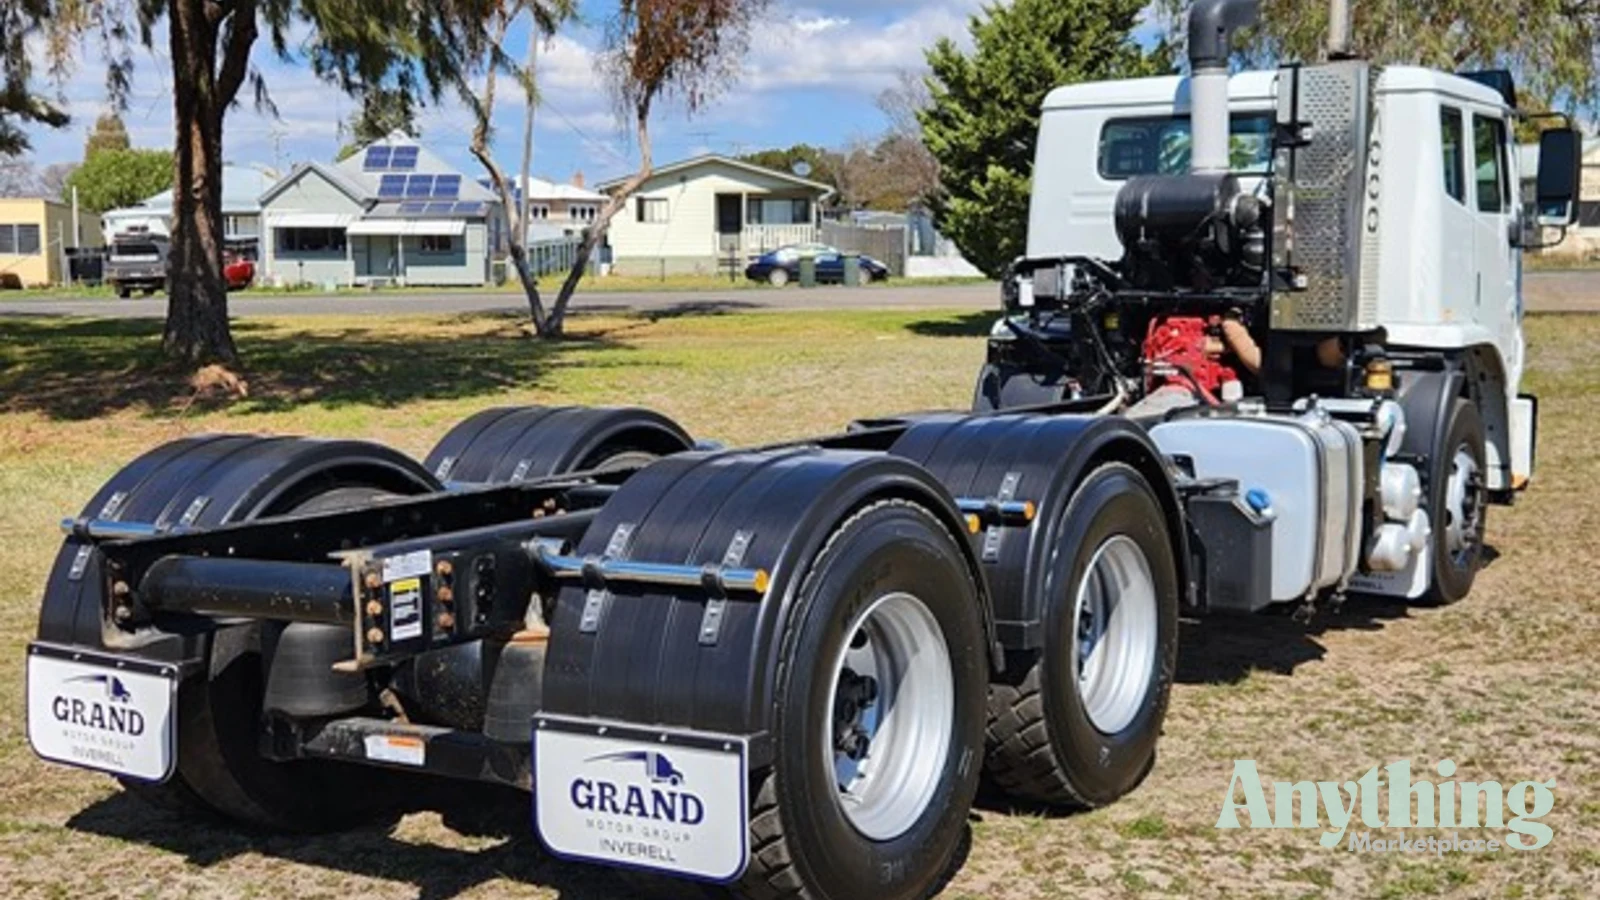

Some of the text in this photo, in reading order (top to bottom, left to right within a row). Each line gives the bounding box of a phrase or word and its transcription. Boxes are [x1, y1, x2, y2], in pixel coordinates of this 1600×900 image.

[53, 696, 144, 736] GRAND
[570, 778, 704, 825] GRAND
[586, 819, 691, 842] MOTOR GROUP
[600, 840, 676, 862] INVERELL
